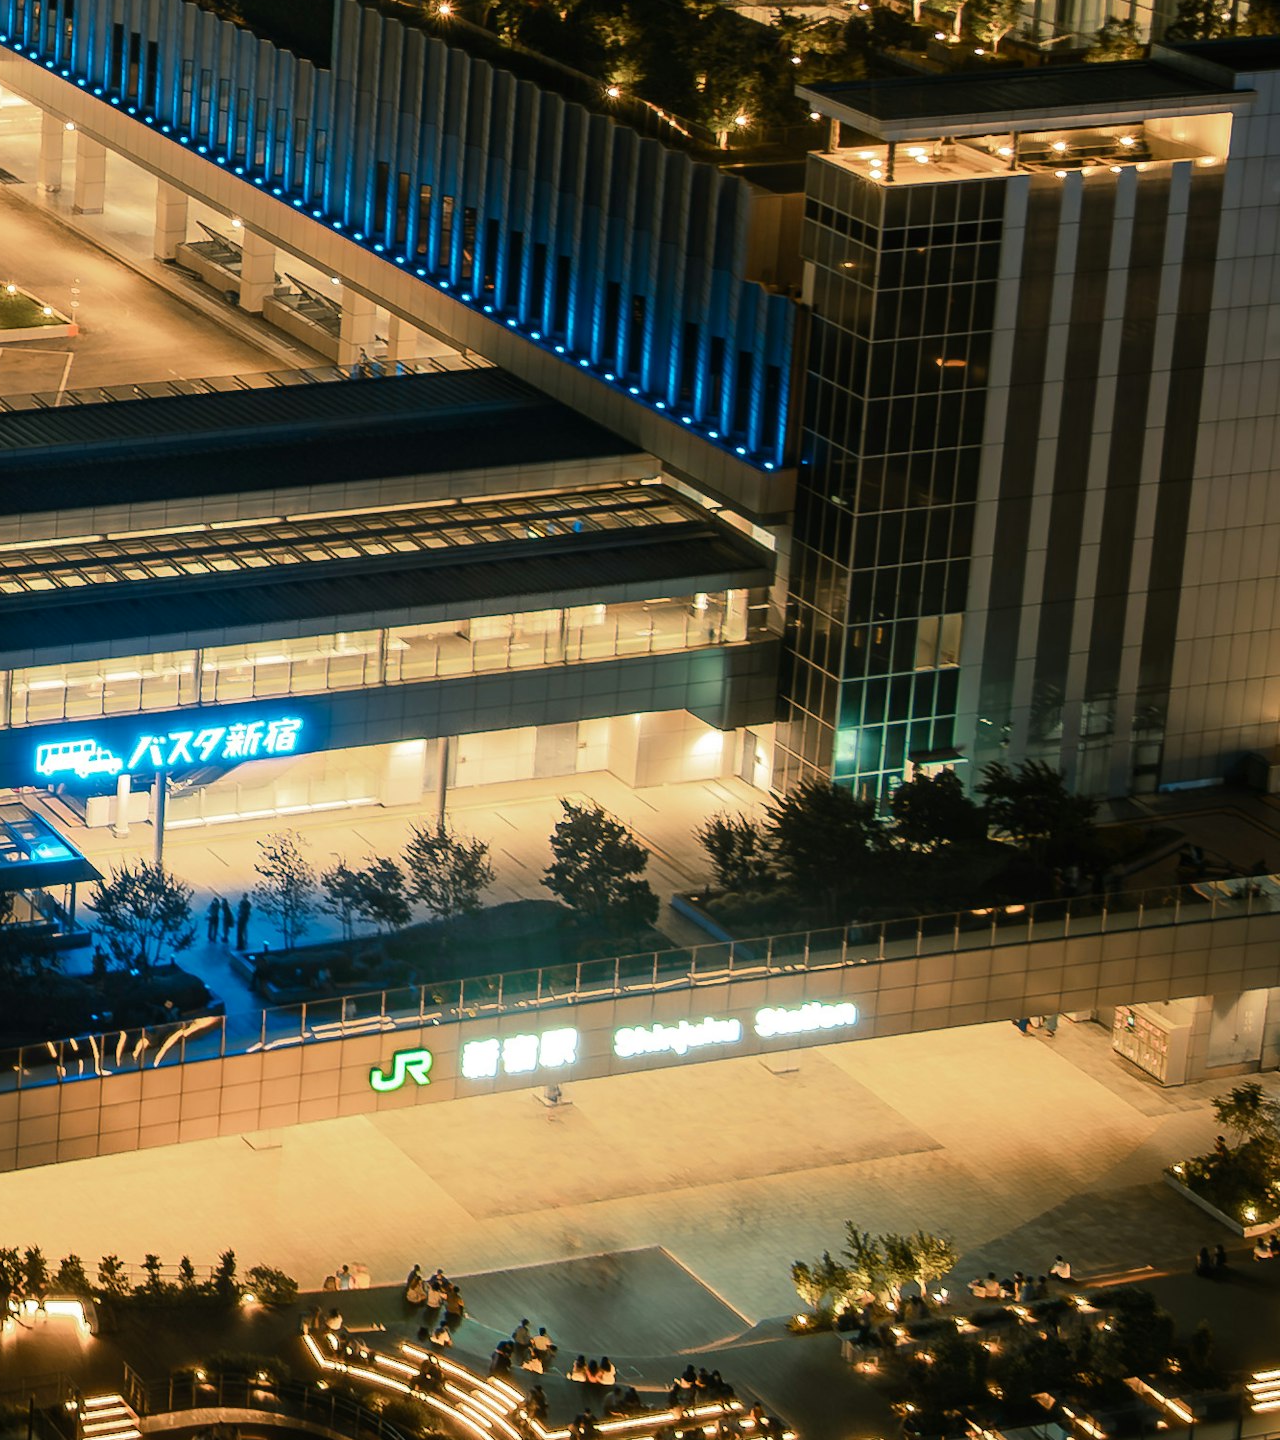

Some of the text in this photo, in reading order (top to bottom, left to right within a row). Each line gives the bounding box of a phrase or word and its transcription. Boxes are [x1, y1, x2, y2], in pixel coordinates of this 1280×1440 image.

[127, 715, 306, 771] バスタ新宿
[368, 1047, 434, 1093] JR
